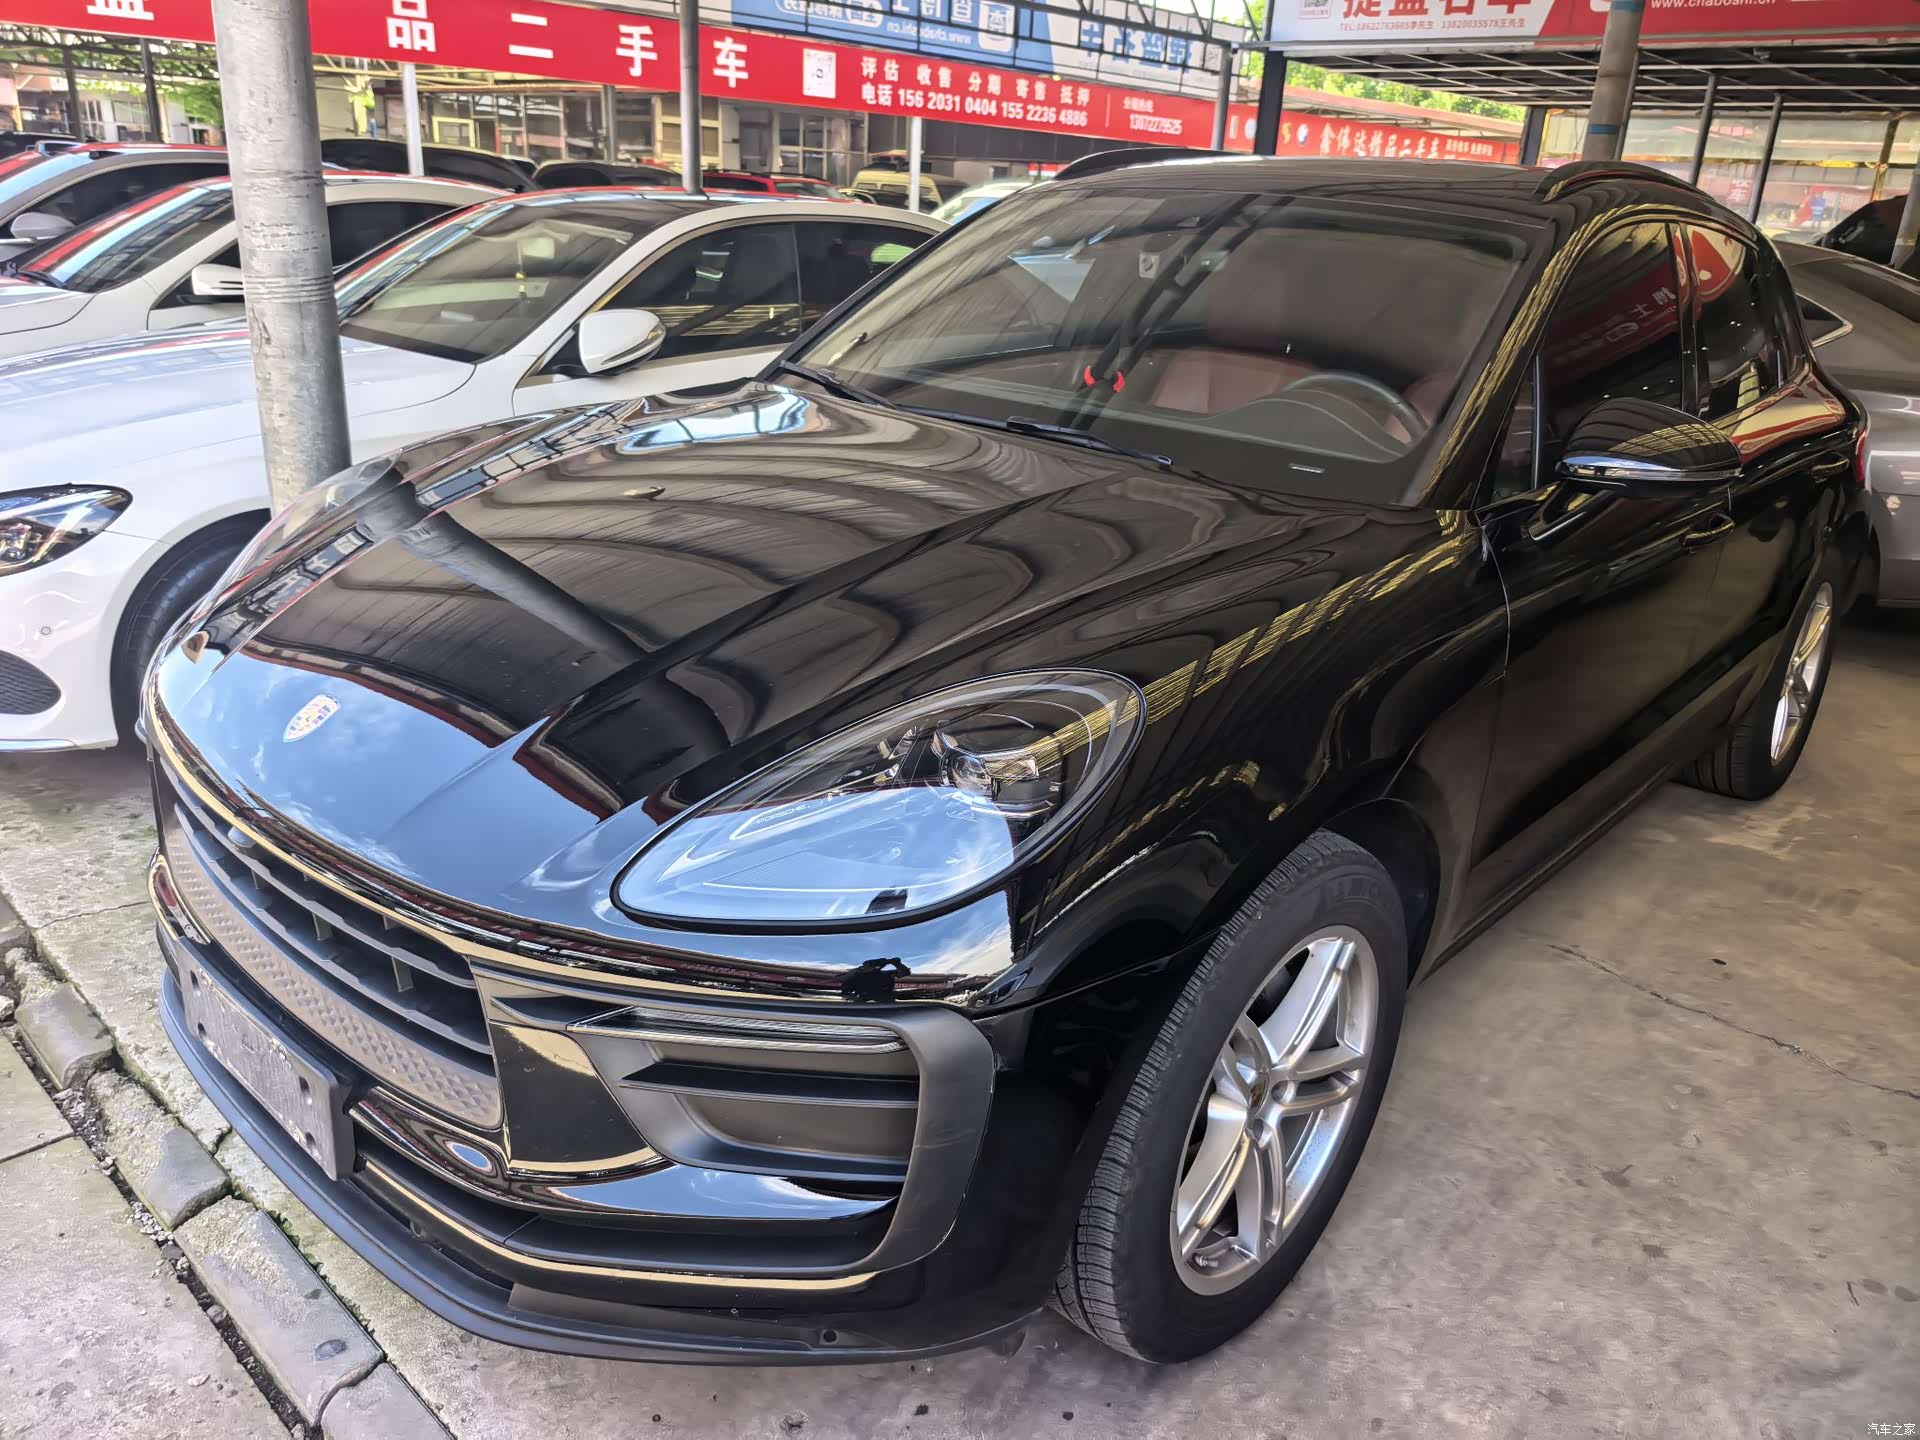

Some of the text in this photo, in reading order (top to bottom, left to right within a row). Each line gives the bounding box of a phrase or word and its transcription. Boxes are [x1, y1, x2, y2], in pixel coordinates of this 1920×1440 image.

[860, 56, 899, 82] 评估
[968, 71, 1002, 96] 分期
[861, 82, 893, 107] 电话
[898, 88, 924, 108] 156
[927, 92, 961, 112] 2031
[965, 97, 997, 116] 0404
[1001, 101, 1024, 119] 155
[1026, 104, 1057, 123] 2236
